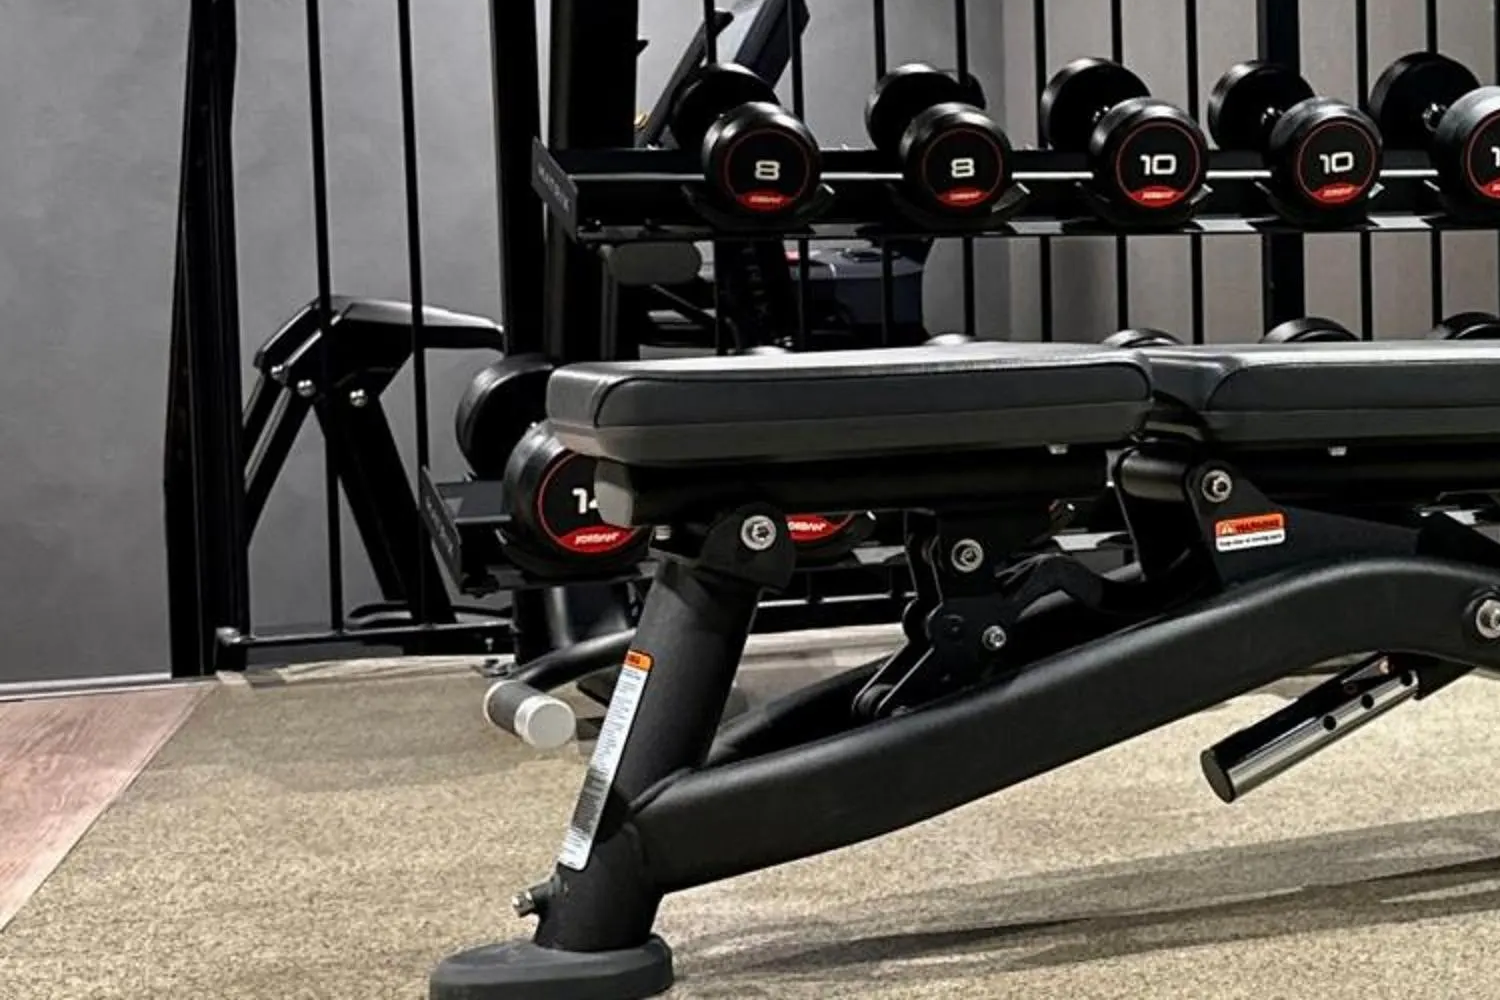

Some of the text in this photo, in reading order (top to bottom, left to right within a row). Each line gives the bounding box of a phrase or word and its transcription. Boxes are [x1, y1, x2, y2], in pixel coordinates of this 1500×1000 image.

[754, 159, 781, 181] 8
[951, 157, 976, 178] 8
[1140, 153, 1177, 176] 10
[1319, 151, 1354, 175] 10
[572, 487, 598, 514] 1
